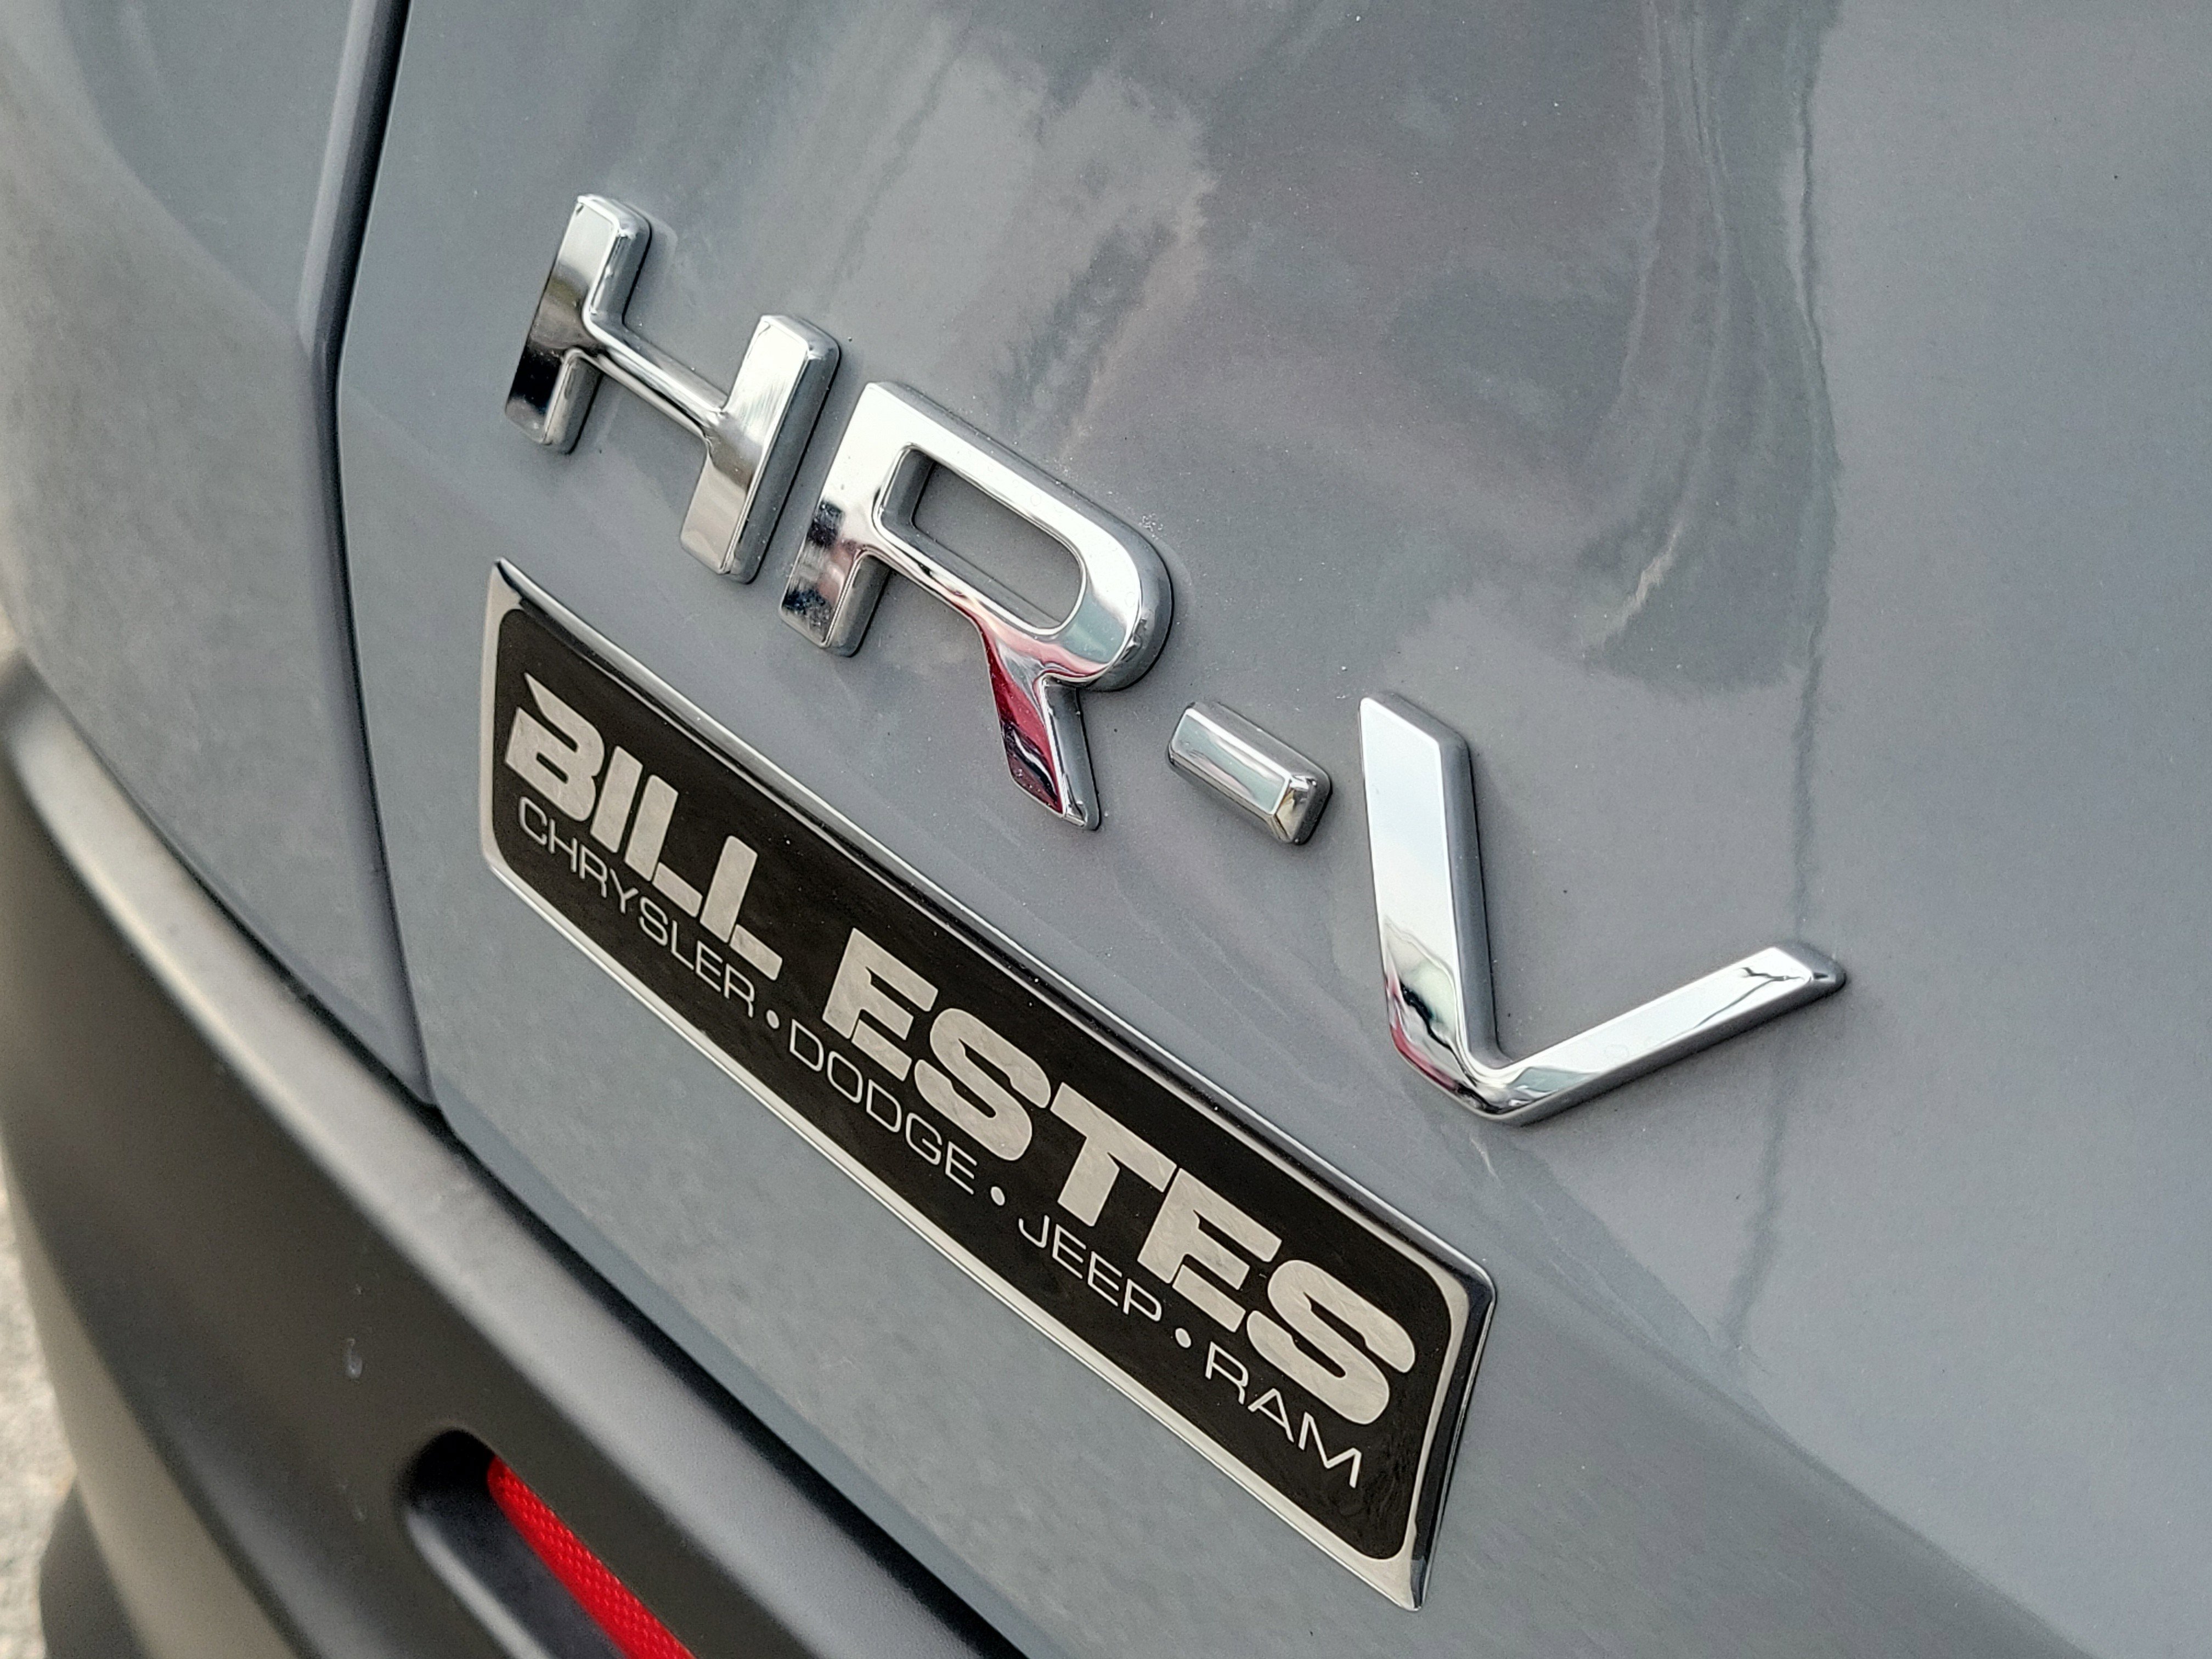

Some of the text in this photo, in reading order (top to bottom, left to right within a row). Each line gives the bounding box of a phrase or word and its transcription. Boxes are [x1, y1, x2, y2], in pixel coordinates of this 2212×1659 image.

[503, 194, 1848, 1127] HR-V
[504, 672, 1416, 1425] BILL ESTES
[517, 795, 1362, 1489] CHRYSLER DODGE JEEP RAM
